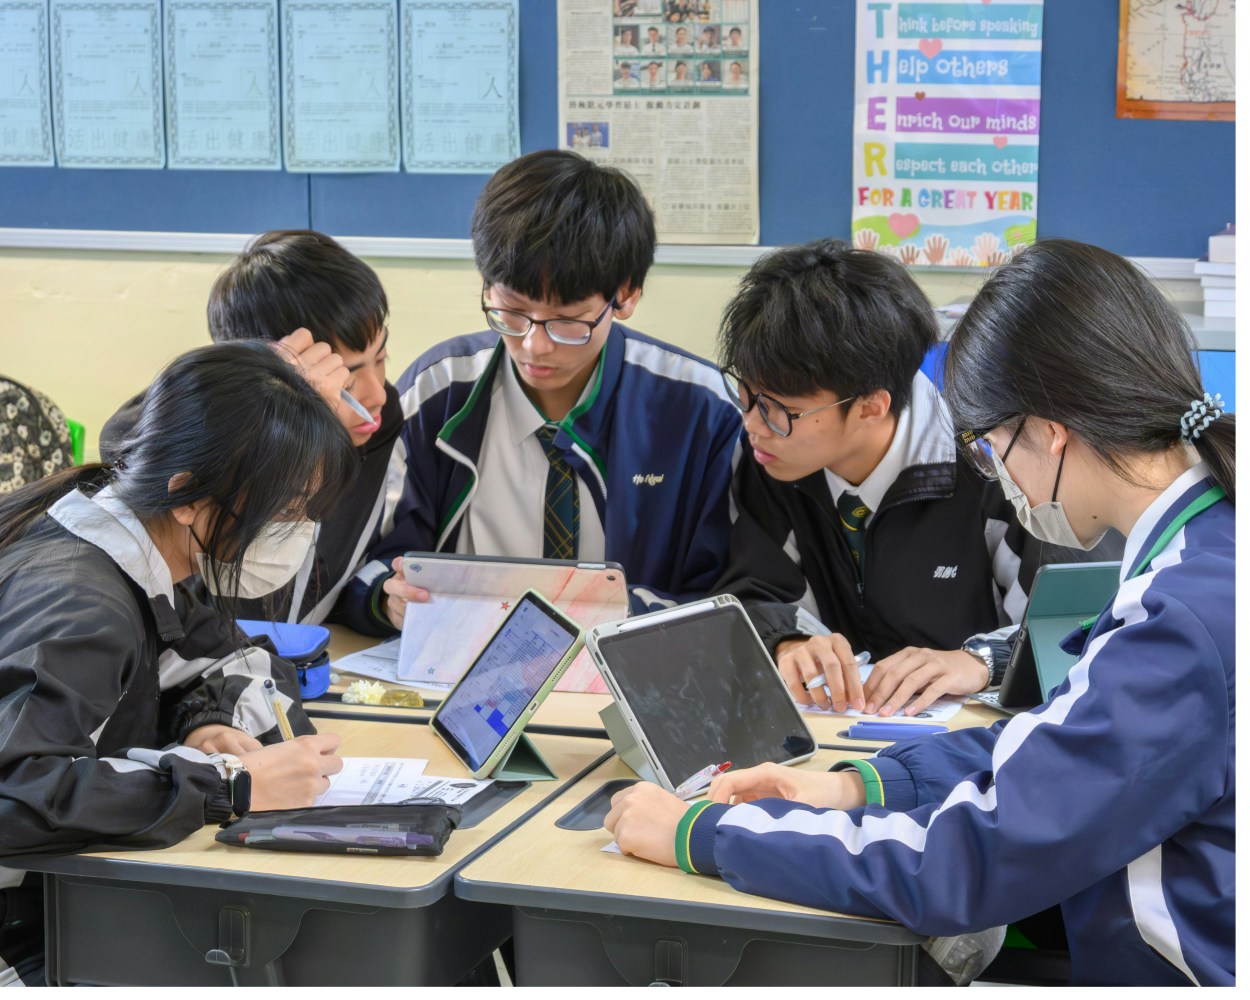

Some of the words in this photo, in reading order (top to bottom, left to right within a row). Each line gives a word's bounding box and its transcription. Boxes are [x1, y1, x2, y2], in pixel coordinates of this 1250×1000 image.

[932, 17, 976, 33] before
[980, 18, 1039, 38] speaking
[986, 114, 1037, 131] minds
[951, 158, 987, 175] each
[858, 187, 894, 206] FOR
[901, 188, 912, 207] A
[918, 188, 977, 209] GREAT
[984, 191, 1034, 210] YEAR
